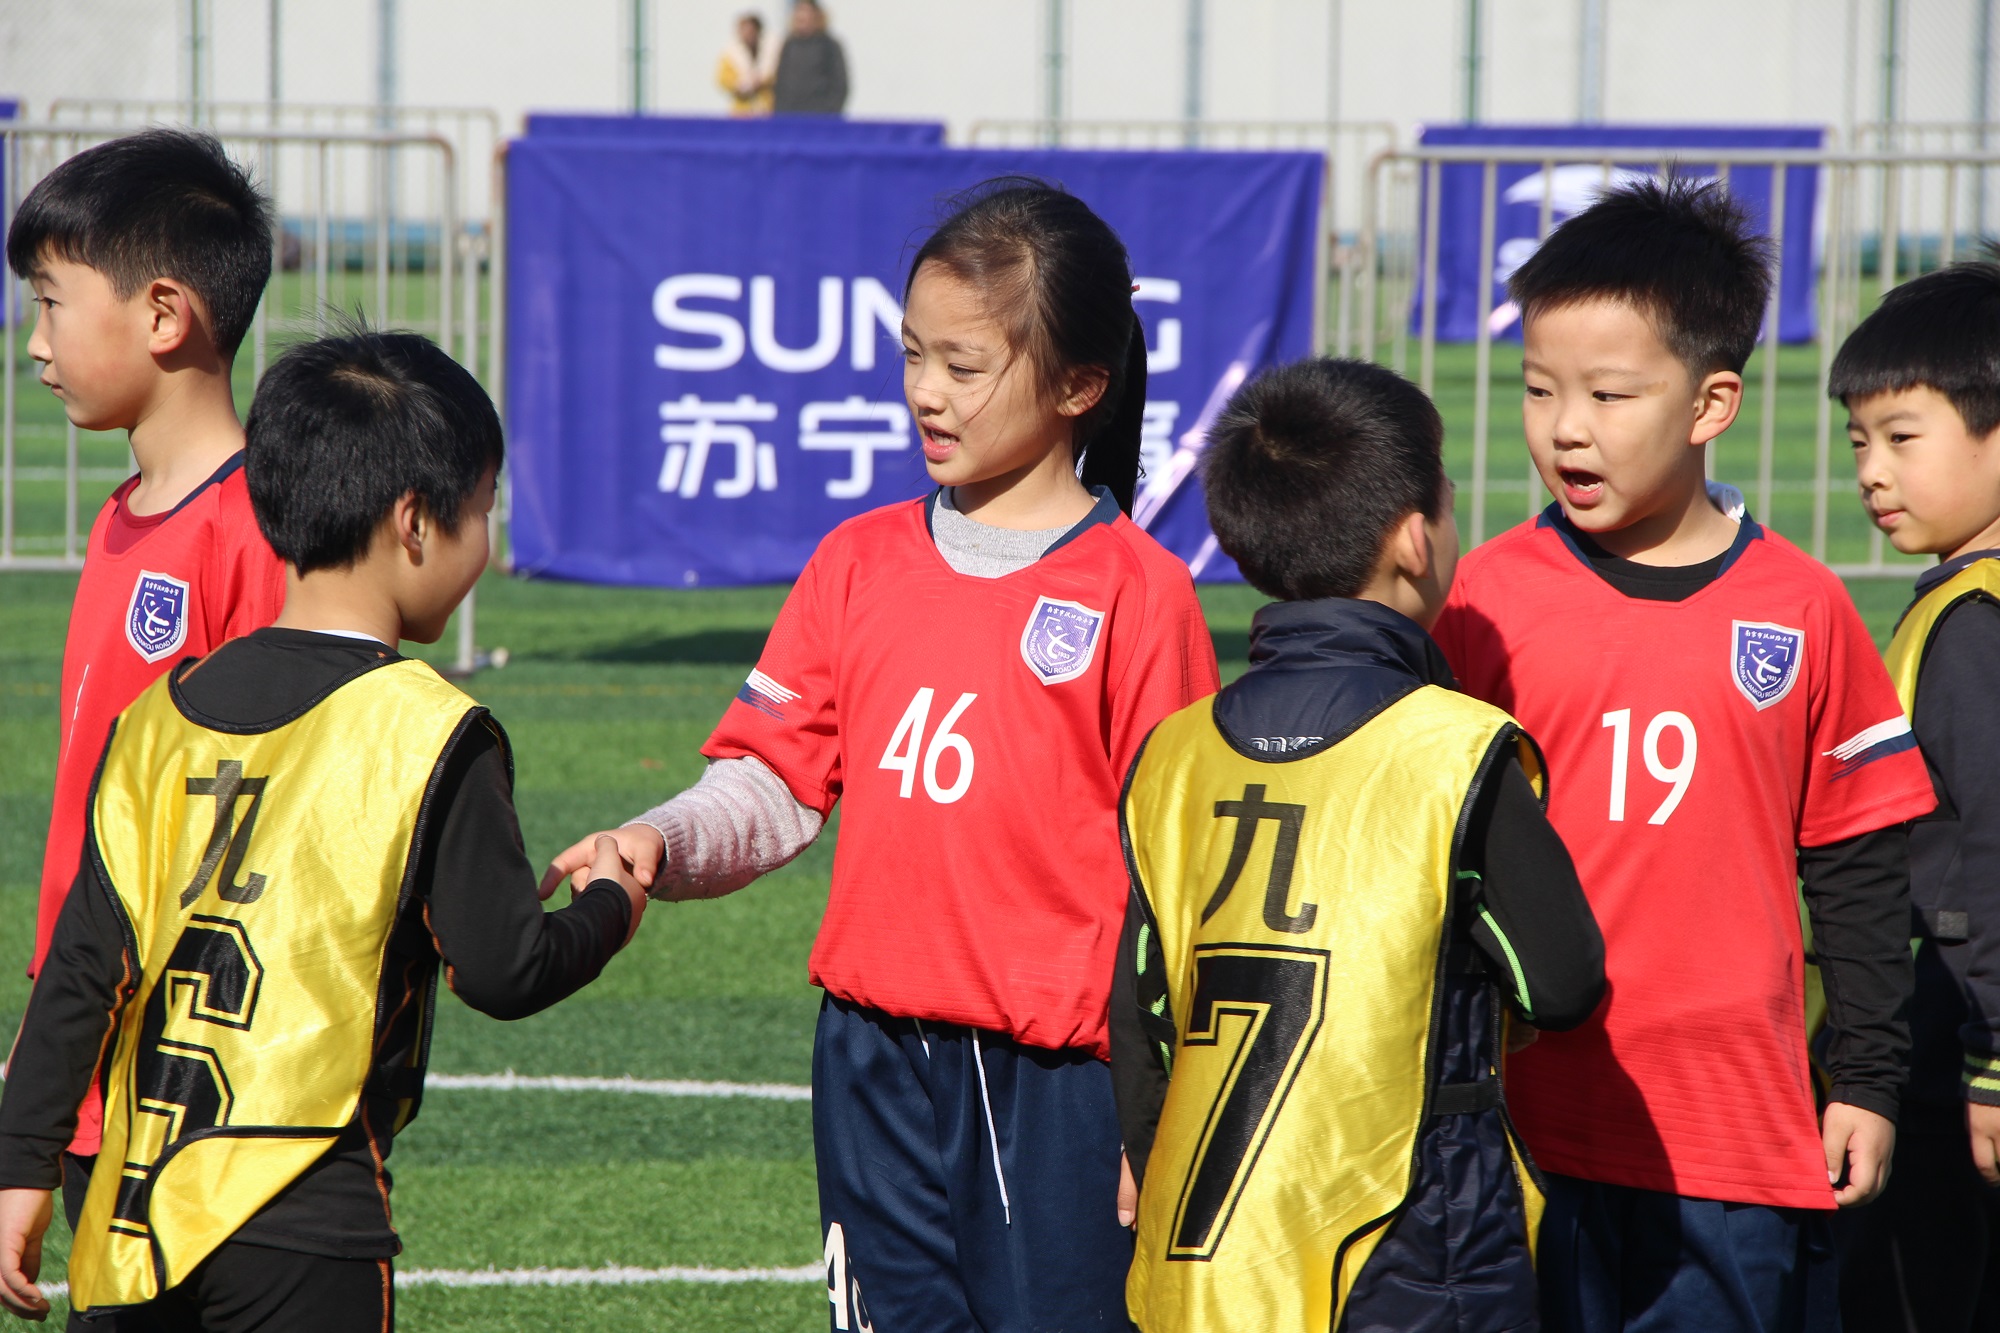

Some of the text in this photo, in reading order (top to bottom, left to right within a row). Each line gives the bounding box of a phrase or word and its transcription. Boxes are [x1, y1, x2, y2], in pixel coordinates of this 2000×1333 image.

[652, 272, 1182, 373] SUNG
[878, 686, 979, 804] 46
[1602, 708, 1698, 826] 19
[180, 759, 269, 910] 九
[1200, 784, 1317, 934] 九
[1166, 942, 1331, 1262] 7
